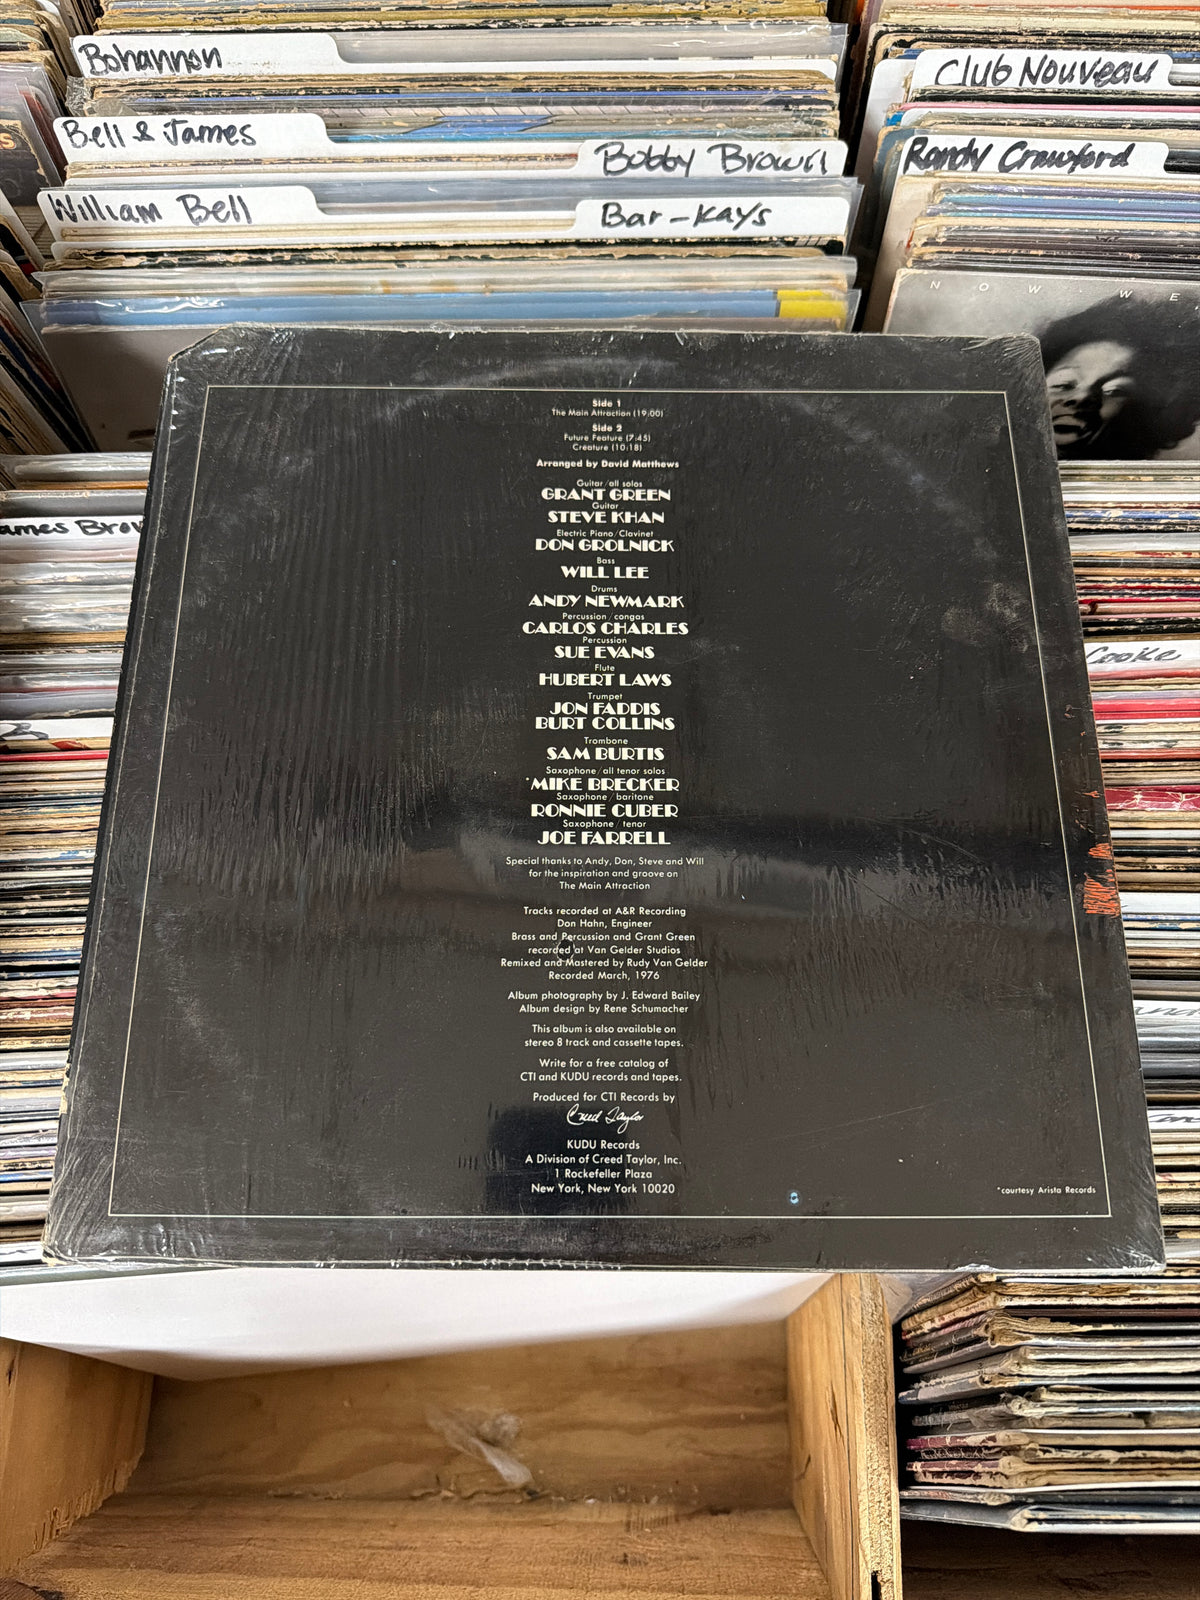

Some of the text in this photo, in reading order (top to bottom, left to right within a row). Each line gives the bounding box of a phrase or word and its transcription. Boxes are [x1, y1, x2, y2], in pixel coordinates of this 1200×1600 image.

[78, 43, 223, 76] Bohannon
[935, 54, 1160, 87] Club Nouveau
[62, 119, 125, 148] Bell
[164, 118, 256, 147] James
[594, 142, 829, 178] Bobby Brown
[903, 136, 1135, 174] Randy Crawford
[48, 193, 253, 225] William Bell
[592, 399, 613, 407] Side
[552, 408, 566, 416] The
[591, 409, 631, 417] Attraction
[592, 424, 613, 432] Side
[564, 433, 589, 441] Future
[592, 433, 623, 442] Feature
[572, 443, 608, 451] Creature
[536, 459, 583, 469] Arranged
[586, 459, 598, 469] by
[632, 460, 679, 468] Matthews
[541, 488, 671, 501] GRANT GREEN
[548, 511, 664, 523] STEVE KHAN
[0, 522, 69, 536] ames
[535, 539, 674, 552] DON GROLNICK
[561, 566, 649, 579] WILL LEE
[528, 594, 684, 608] ANDY NEWMARK
[522, 621, 689, 635] CARLOS CHARLES
[582, 636, 627, 644] Percussion
[554, 646, 655, 659] SUE EVANS
[539, 673, 672, 686] HUBERT LAWS
[588, 692, 623, 701] Trumpet
[550, 702, 661, 715] JON FADDIS
[535, 717, 675, 730] BURT COLLINS
[584, 737, 628, 745] Trombone
[547, 747, 664, 761] SAM BURTIS
[588, 778, 679, 791] BRECKER
[531, 804, 678, 818] RONNIE CUBER
[537, 831, 671, 845] JOE FARRELL
[506, 856, 539, 866] Special
[542, 857, 571, 865] thanks
[585, 857, 612, 866] Andy,
[615, 857, 636, 866] Don,
[639, 857, 663, 865] Steve
[665, 857, 683, 865] and
[686, 857, 704, 865] Will
[559, 881, 650, 890] The Main Attraction
[524, 907, 553, 915] Tracks
[557, 907, 598, 915] recorded
[615, 907, 635, 915] A&R
[639, 907, 686, 917] Recording
[557, 919, 652, 929] Don Hahn, Engineer
[512, 932, 695, 941] Brass and Percussion and Grant Green
[528, 946, 680, 954] recorded at Van Gelder Studios
[501, 958, 708, 969] Remixed and Mastered by Rudy Van Gelder
[549, 971, 660, 981] Recorded March, 1976
[508, 991, 538, 1000] Album
[541, 991, 603, 1001] photography
[606, 991, 618, 1001] by
[632, 991, 668, 1000] Edward
[671, 991, 700, 1001] Bailey
[519, 1004, 688, 1014] Album design by Rene Schumacher
[520, 1072, 682, 1083] CTI and KUDU records and tapes.
[533, 1092, 675, 1103] Produced for CTI Records by
[567, 1139, 640, 1150] KUDU Records
[537, 1154, 575, 1164] Division
[578, 1154, 589, 1164] of
[592, 1154, 623, 1164] Creed
[626, 1154, 660, 1165] Taylor,
[664, 1154, 682, 1164] Inc.
[565, 1168, 621, 1178] Rockefeller
[625, 1169, 652, 1179] Plaza
[531, 1183, 675, 1194] New York, New York 10020
[1038, 1186, 1062, 1194] Arista
[1065, 1186, 1096, 1194] Records
